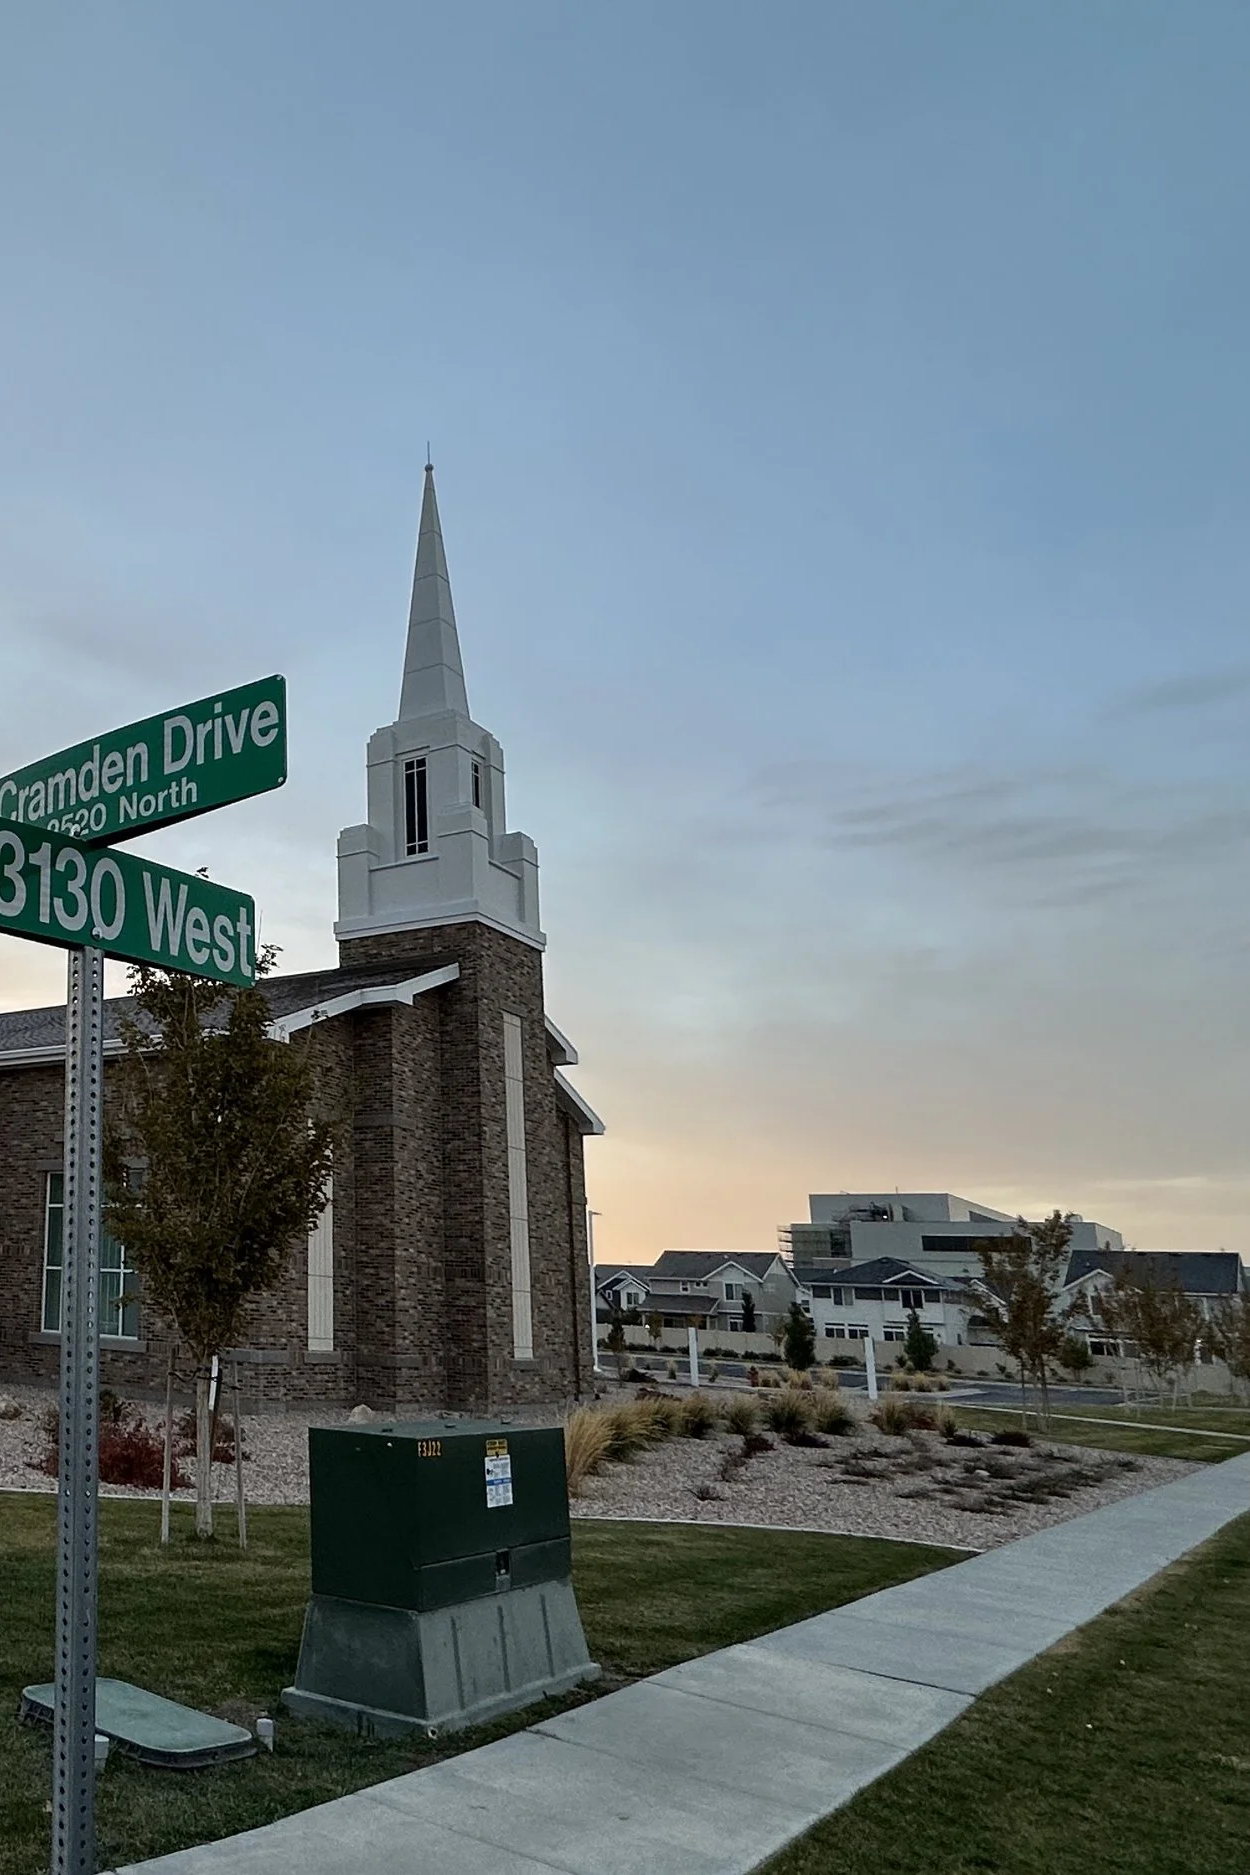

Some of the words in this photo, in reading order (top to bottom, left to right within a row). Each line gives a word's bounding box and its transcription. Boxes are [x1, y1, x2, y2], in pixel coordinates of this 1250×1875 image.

[163, 701, 279, 775] Drive
[119, 781, 198, 823] North
[142, 871, 253, 977] West
